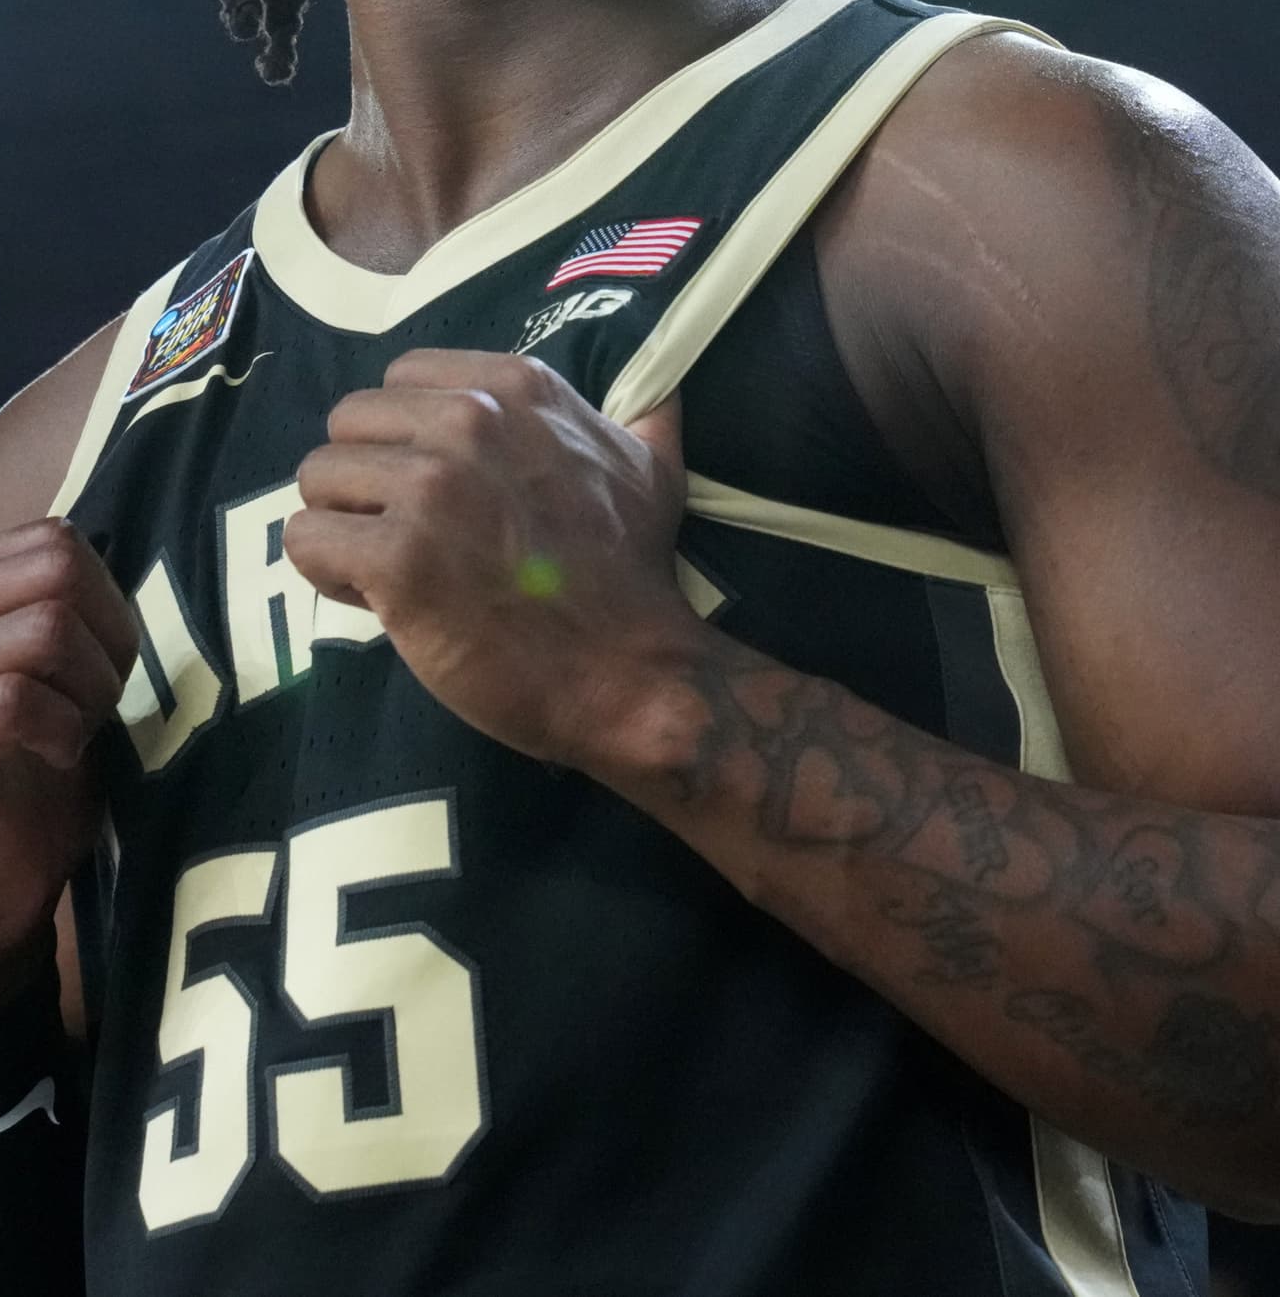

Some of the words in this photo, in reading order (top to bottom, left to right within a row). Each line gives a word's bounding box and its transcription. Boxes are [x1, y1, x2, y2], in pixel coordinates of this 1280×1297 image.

[149, 301, 217, 370] FOUR
[156, 283, 223, 349] FINAL
[138, 789, 489, 1239] 55
